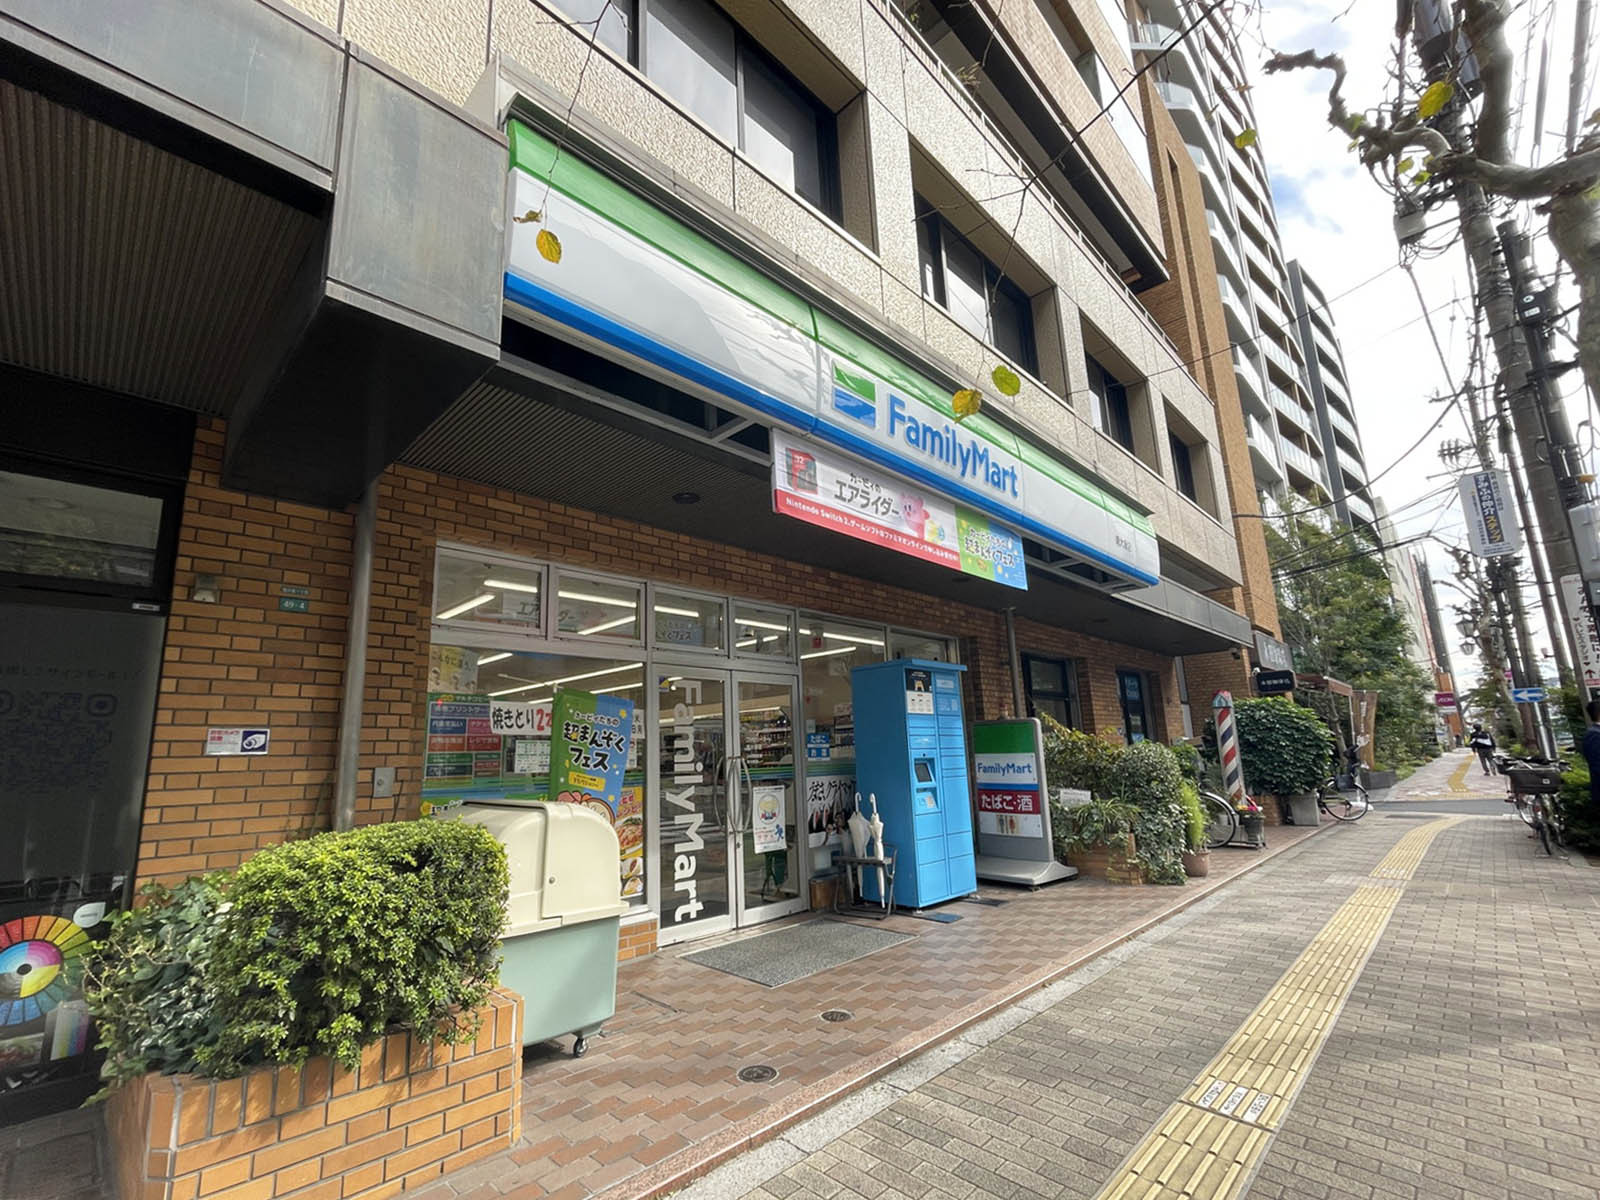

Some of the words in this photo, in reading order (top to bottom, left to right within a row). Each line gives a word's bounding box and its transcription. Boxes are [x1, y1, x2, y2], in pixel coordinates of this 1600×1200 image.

[888, 393, 1019, 498] FamilyMart
[850, 472, 882, 493] カービィの
[785, 497, 820, 516] Nintendo
[820, 508, 844, 523] Switch
[834, 479, 901, 517] エアライダー
[575, 711, 620, 727] カービィたちの
[563, 720, 626, 754] 超まんぞく
[569, 746, 609, 771] フェス
[977, 762, 1033, 777] FamilyMart
[665, 680, 705, 923] FamilyMart
[980, 793, 1034, 812] たばこ・酒
